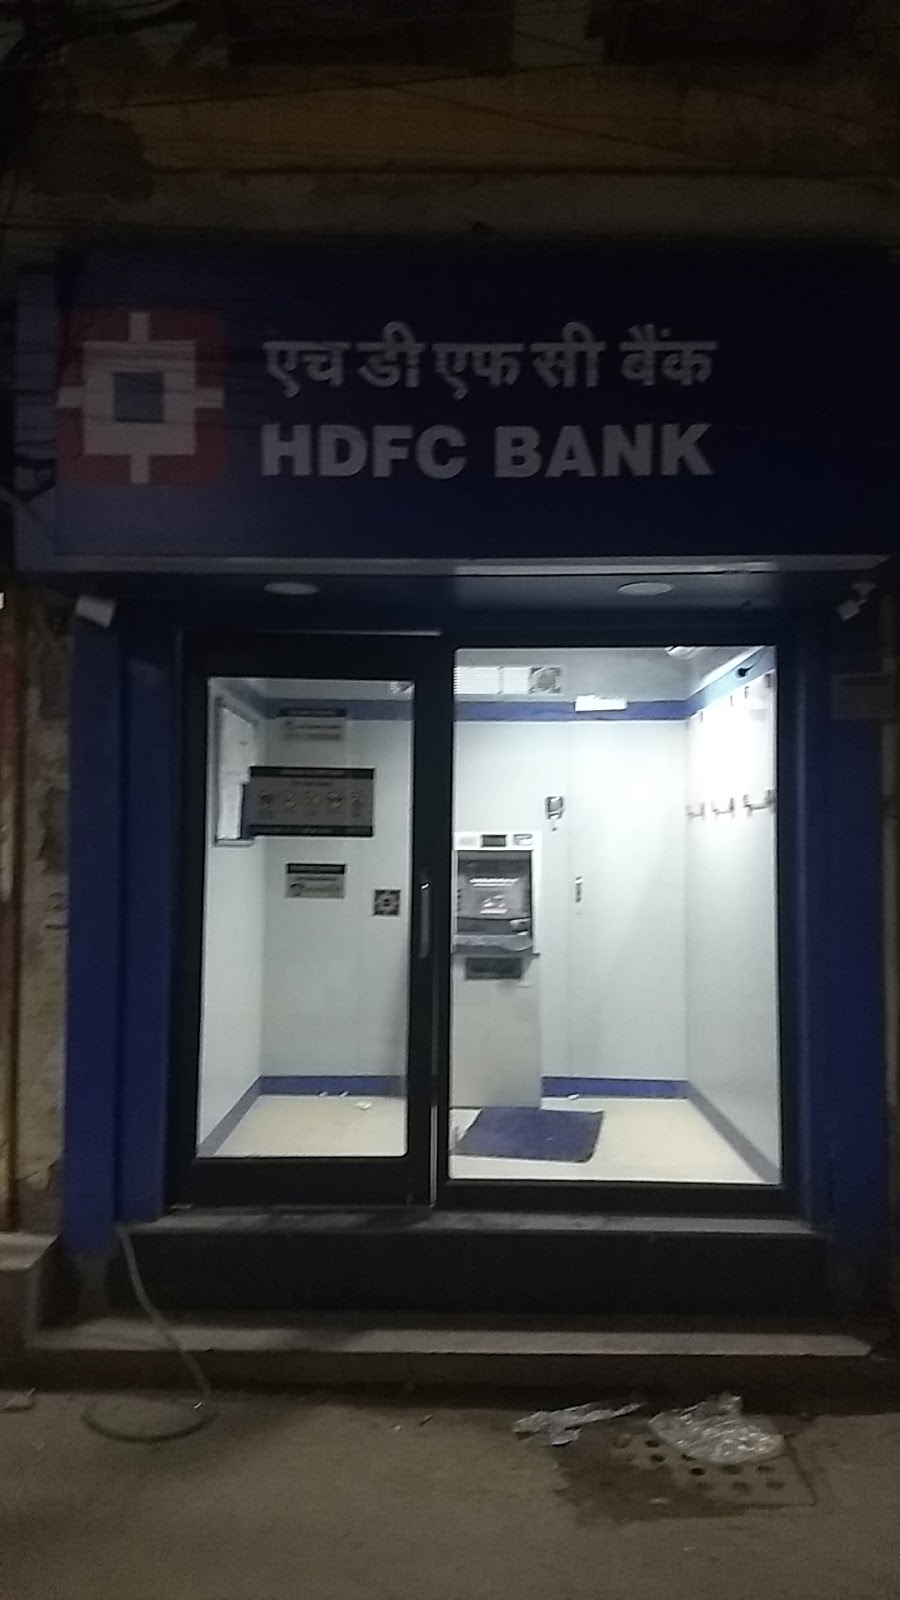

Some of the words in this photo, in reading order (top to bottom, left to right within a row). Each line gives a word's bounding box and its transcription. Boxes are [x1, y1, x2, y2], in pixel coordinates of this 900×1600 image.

[619, 323, 719, 387] बैंक
[260, 423, 467, 480] HDFC
[494, 422, 713, 479] BANK
